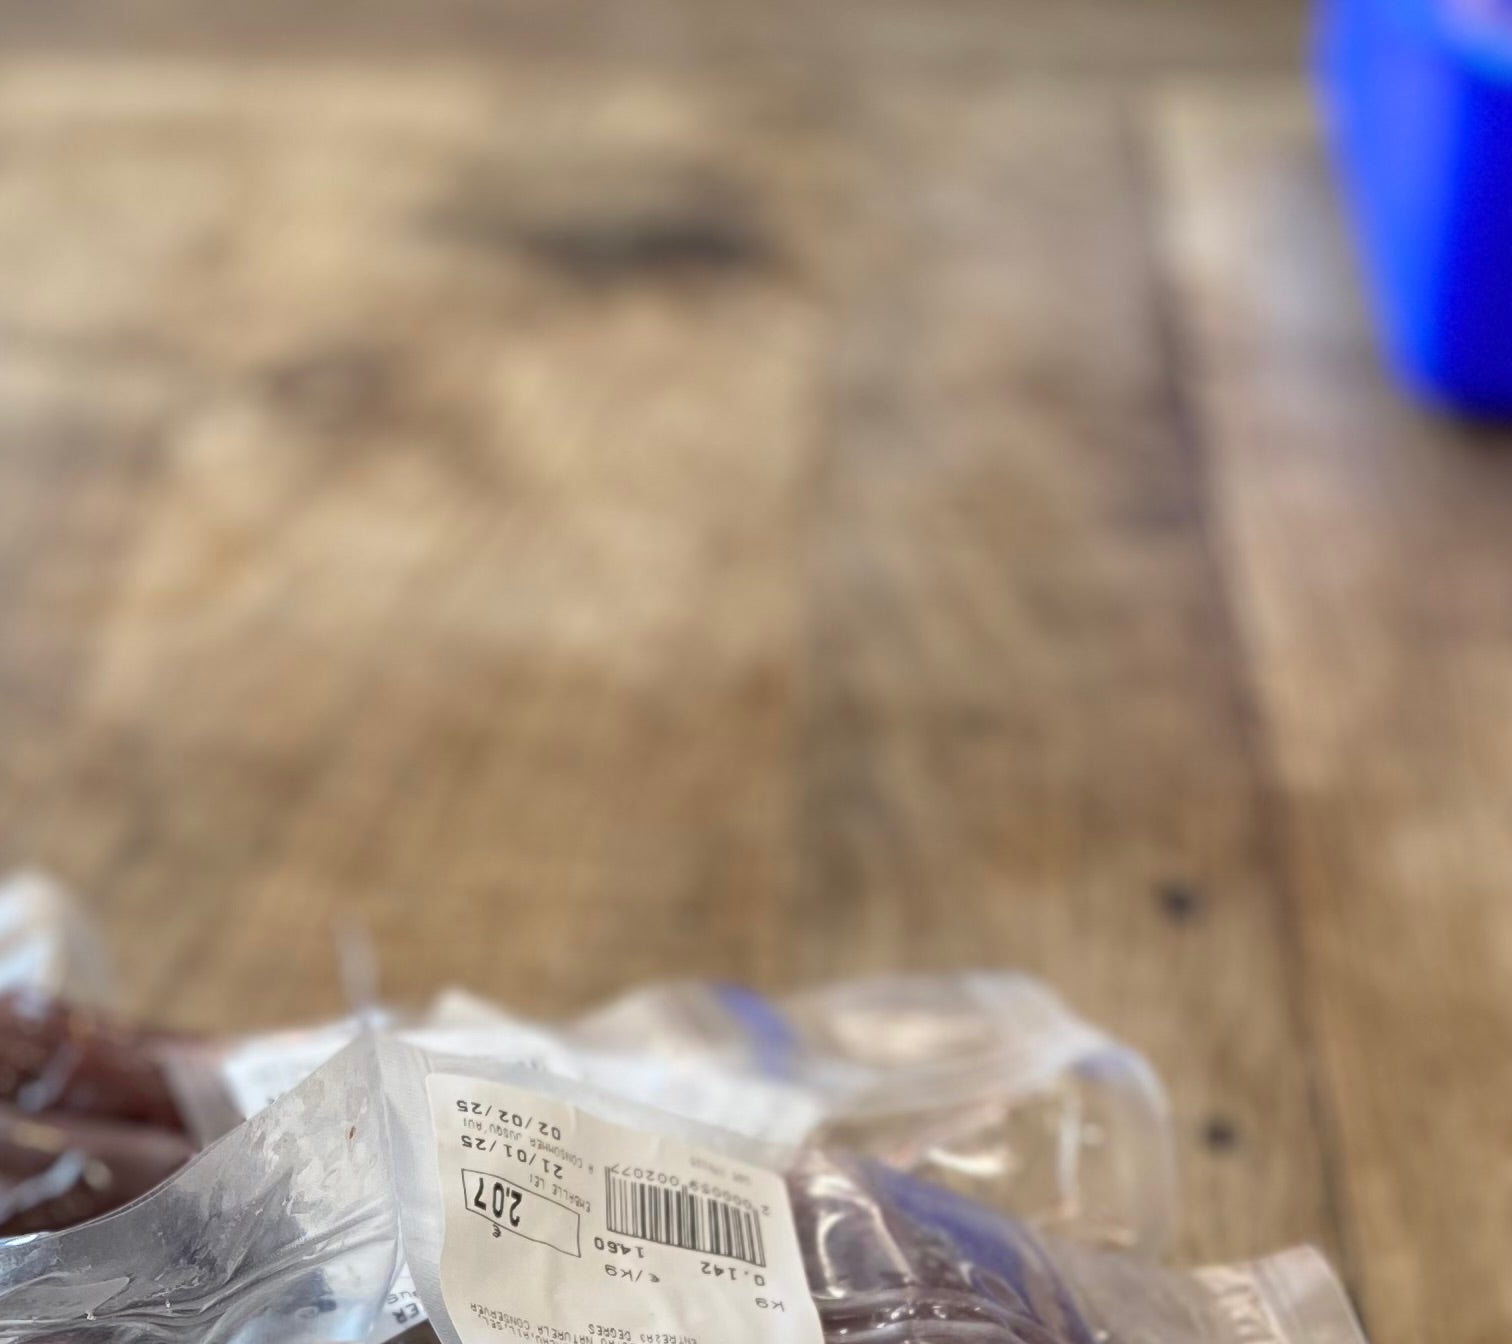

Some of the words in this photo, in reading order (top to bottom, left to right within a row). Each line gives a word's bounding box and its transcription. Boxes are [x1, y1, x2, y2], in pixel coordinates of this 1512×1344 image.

[474, 1177, 522, 1227] 2.07
[700, 1261, 766, 1287] 0.142
[587, 1323, 631, 1342] DEGRES
